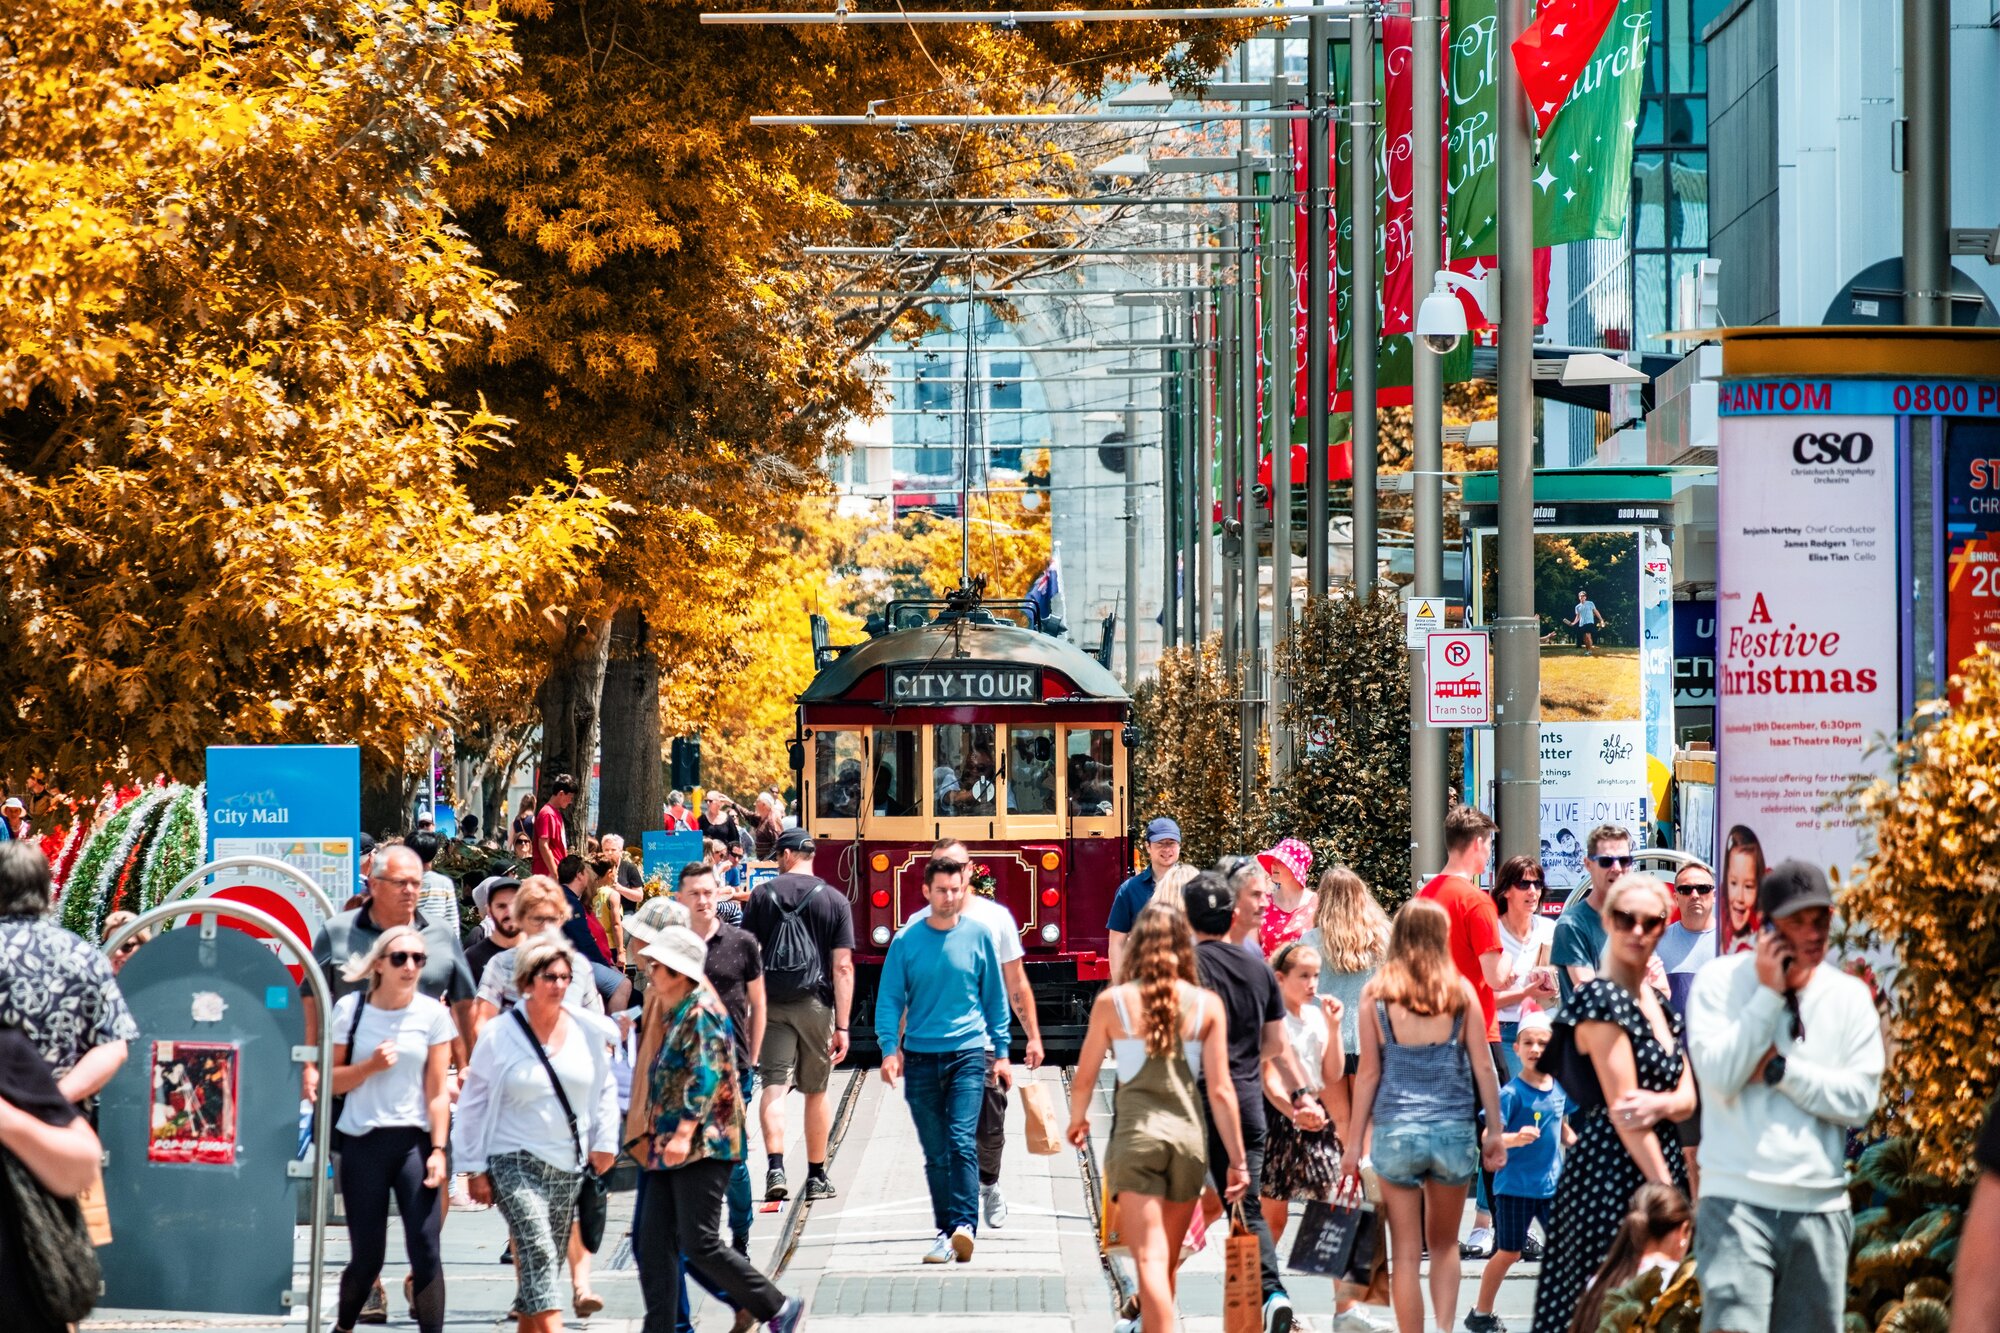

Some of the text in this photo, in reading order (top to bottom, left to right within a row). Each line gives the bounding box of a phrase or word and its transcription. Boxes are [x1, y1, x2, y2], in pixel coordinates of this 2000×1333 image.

[1893, 385, 1968, 412] 0800
[1792, 431, 1874, 466] CSO
[1791, 467, 1876, 479] Christchurch Symphony
[1813, 476, 1850, 485] Orchestra
[1618, 508, 1635, 519] 0800
[1635, 508, 1659, 520] PHANTOM
[1771, 525, 1802, 537] Northey
[1805, 525, 1828, 534] Chief
[1829, 525, 1876, 535] Conductor
[1783, 539, 1876, 551] James Rodgers Tenor
[1808, 552, 1876, 562] Elise Tian Cello
[1970, 552, 1998, 562] ENROL
[1748, 591, 1773, 624] A
[1728, 623, 1840, 659] Festive
[894, 673, 1033, 697] CITY TOUR
[1435, 705, 1483, 716] Tram Stop
[1753, 721, 1769, 732] 19th
[1770, 721, 1818, 732] December,
[1820, 720, 1862, 732] 6:30pm
[1602, 734, 1621, 748] all
[1769, 736, 1862, 748] Isaac Theatre Royal
[1545, 768, 1571, 778] things
[1751, 774, 1778, 783] musical
[1779, 773, 1813, 785] offering
[1815, 773, 1829, 783] for
[1830, 773, 1845, 783] the
[1597, 778, 1636, 786] allright.org.nz
[1783, 789, 1801, 798] Join
[1803, 790, 1813, 798] us
[1555, 802, 1579, 821] LIVE
[1590, 802, 1611, 821] JOY
[1614, 802, 1635, 821] LIVE
[1760, 804, 1808, 815] celebration,
[213, 807, 289, 827] City Mall
[1796, 819, 1814, 828] and
